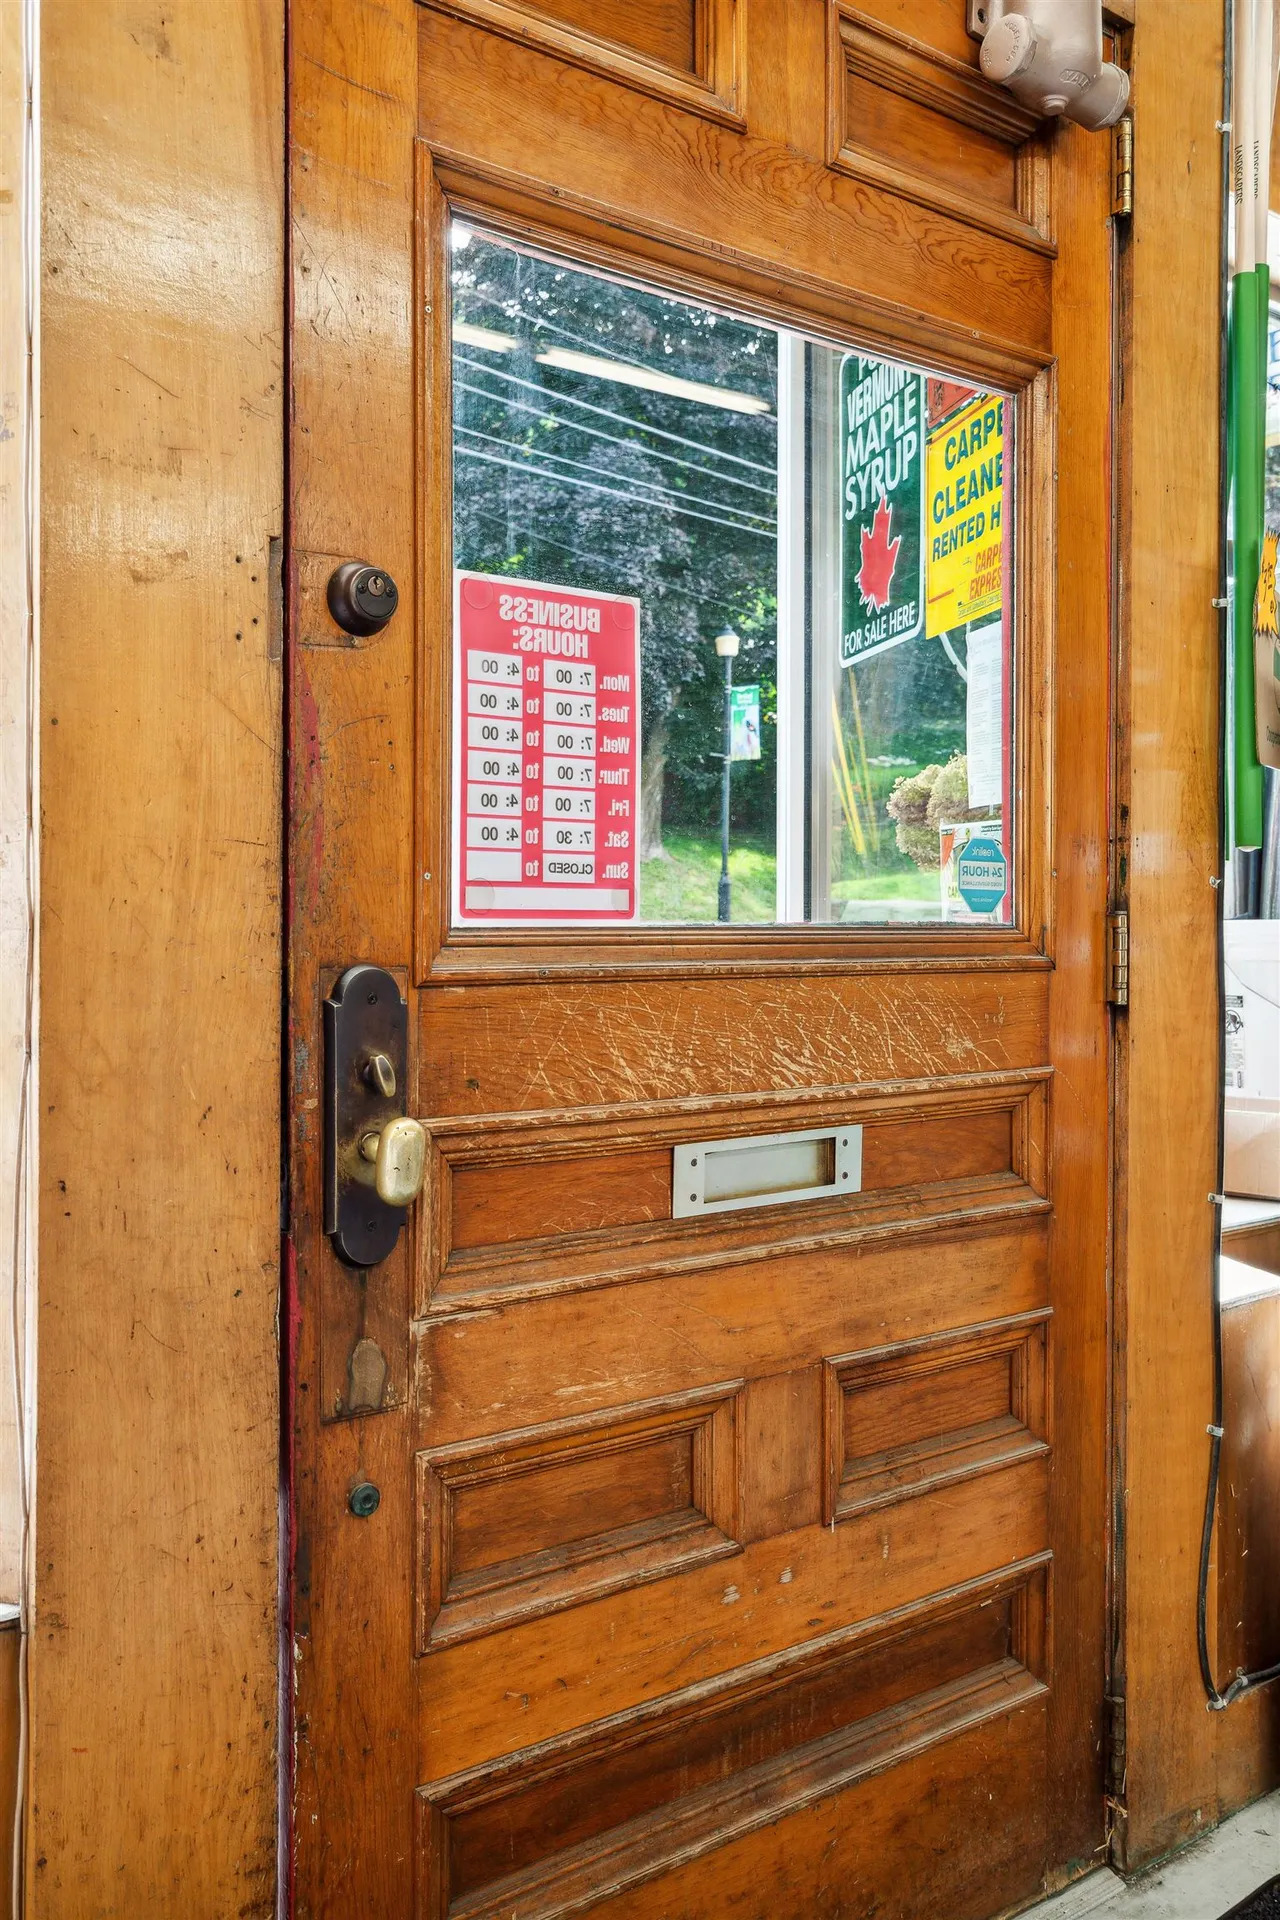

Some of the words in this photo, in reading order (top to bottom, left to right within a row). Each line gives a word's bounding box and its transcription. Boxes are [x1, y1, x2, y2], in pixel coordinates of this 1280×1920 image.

[845, 380, 917, 478] MAPLE
[845, 431, 918, 521] SYRUP
[932, 511, 985, 562] RENTED
[844, 628, 862, 657] FOR
[864, 615, 887, 647] SALE
[889, 601, 916, 635] HERE
